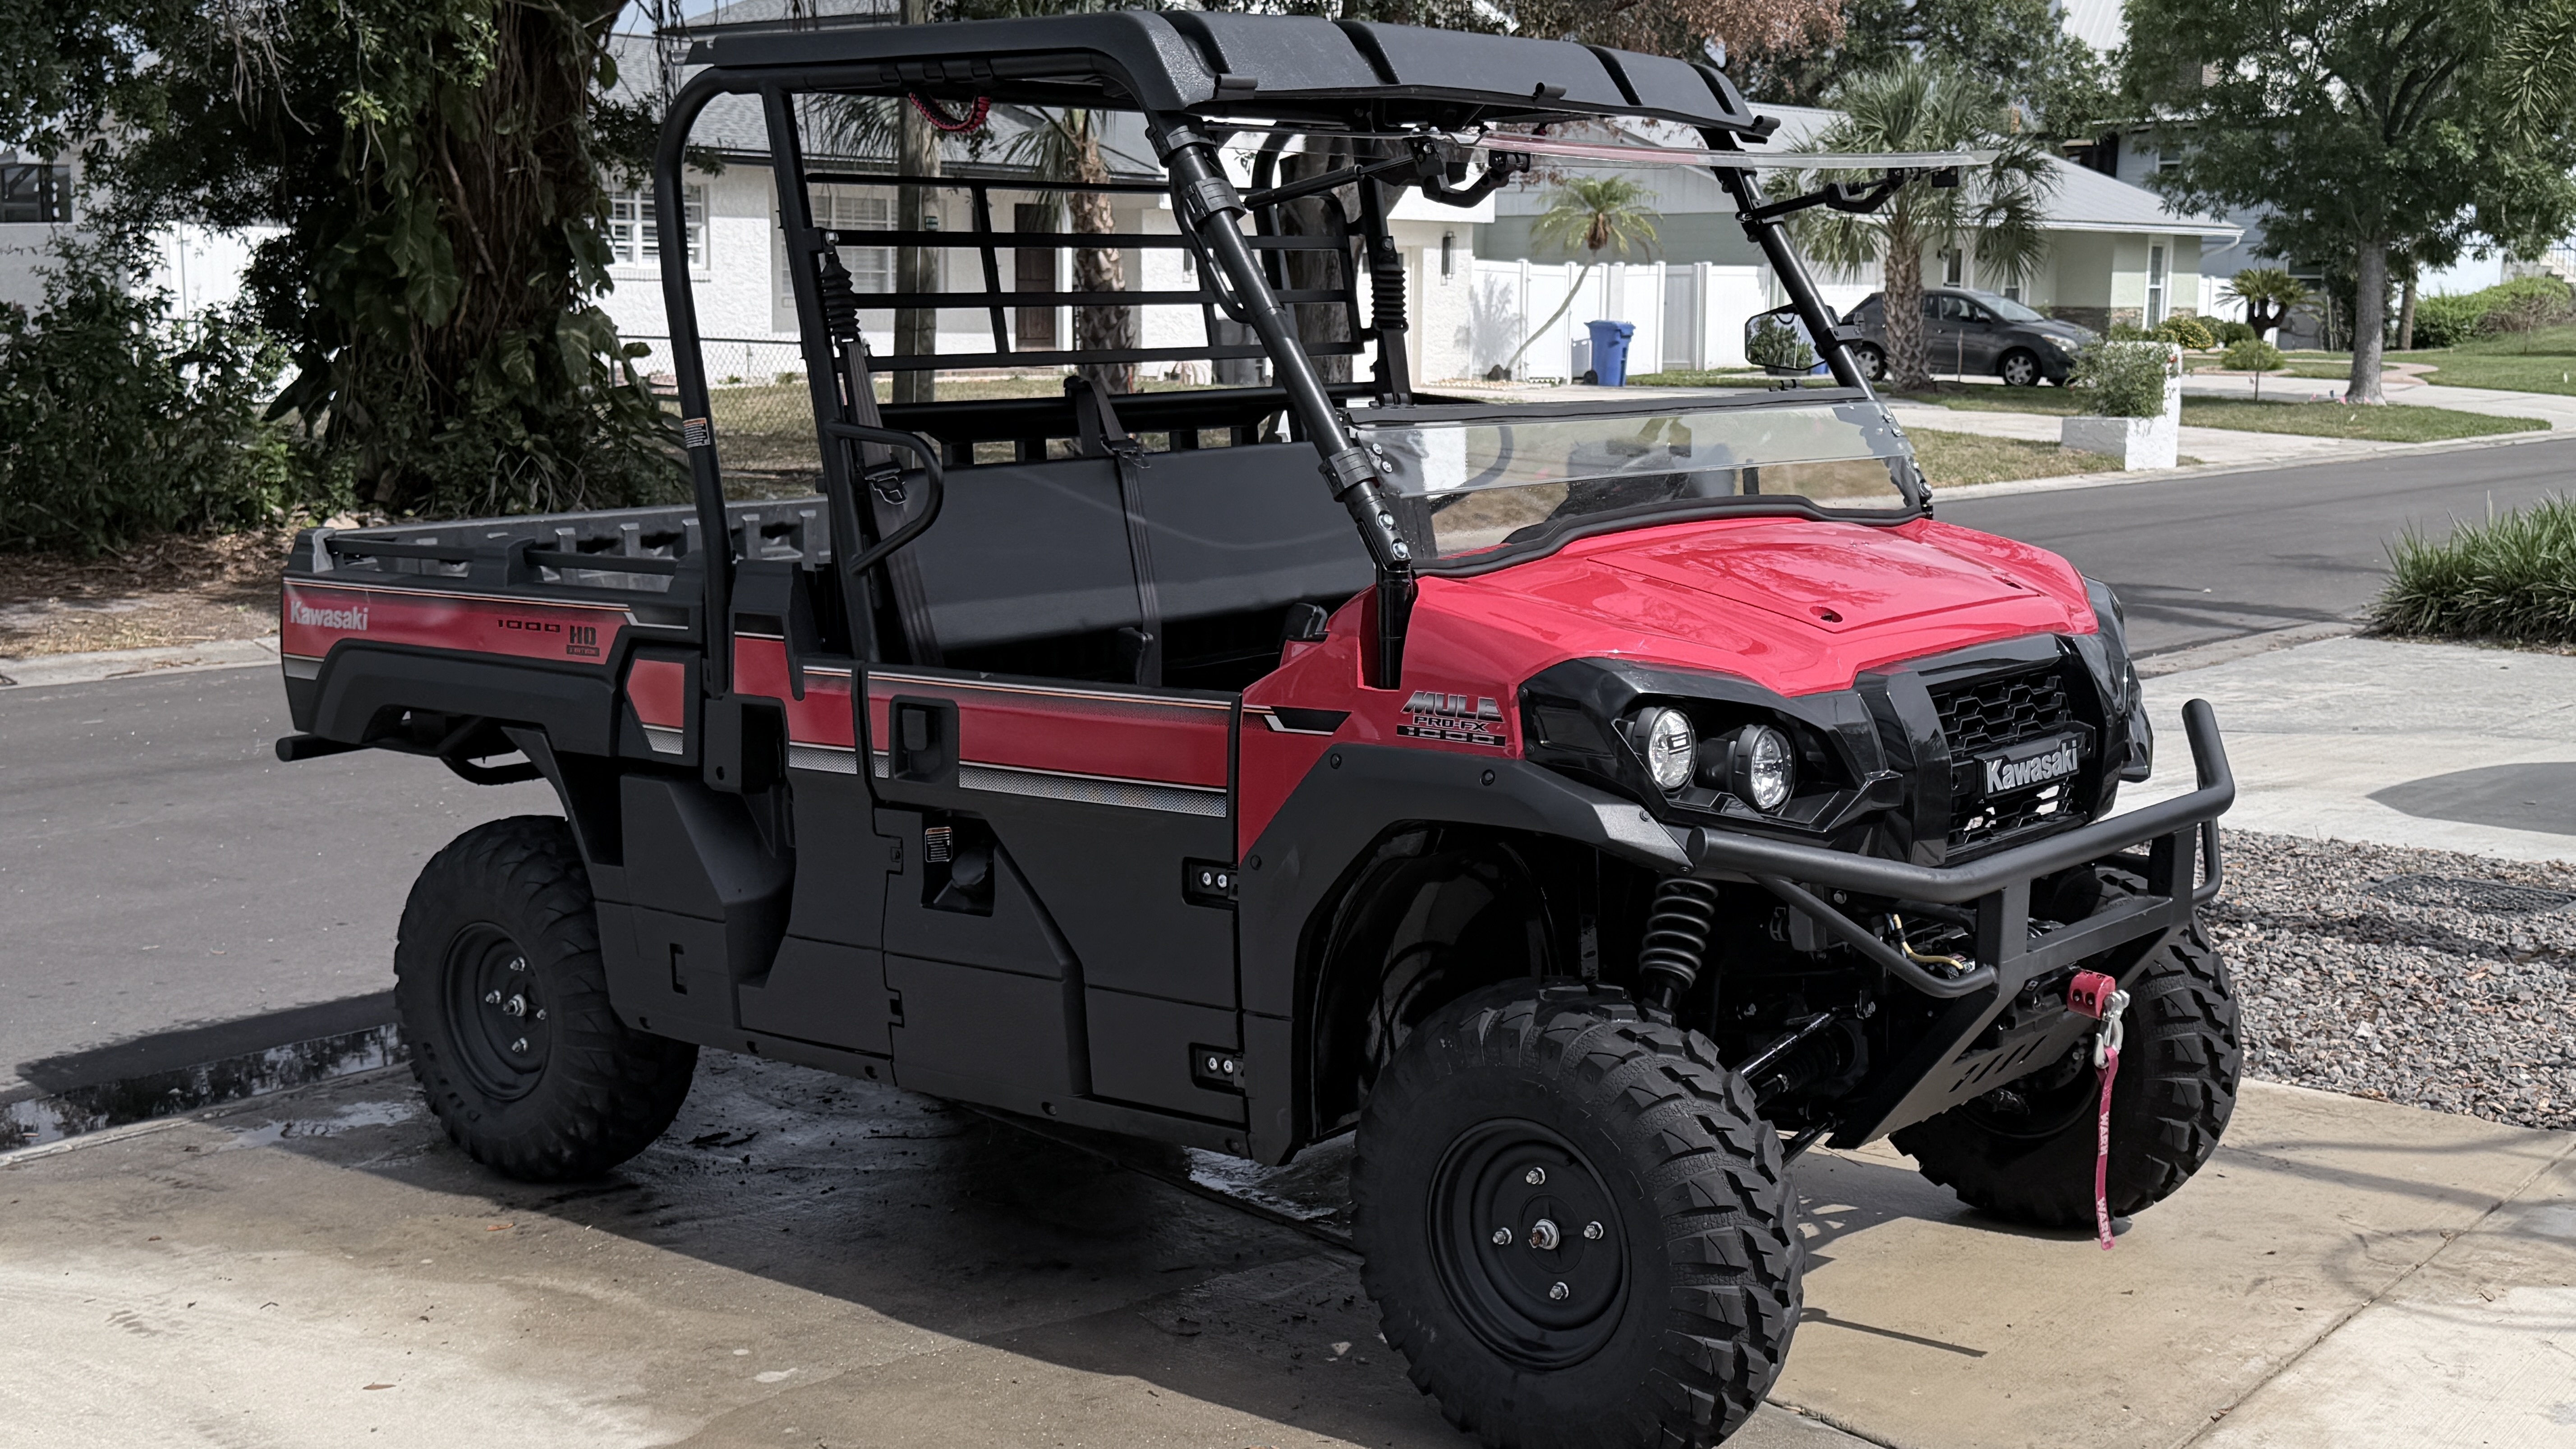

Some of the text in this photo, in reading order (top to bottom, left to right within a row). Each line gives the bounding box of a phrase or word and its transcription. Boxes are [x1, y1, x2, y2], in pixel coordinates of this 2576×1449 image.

[290, 600, 368, 631] Kawasaki
[497, 619, 596, 645] 1000 HD
[1400, 690, 1505, 723] MULE
[1406, 726, 1495, 745] 1000
[1413, 715, 1489, 733] PRO-FX
[1986, 740, 2078, 794] Kawasaki
[2099, 1110, 2110, 1156] WARN
[2097, 1196, 2111, 1243] WARN
